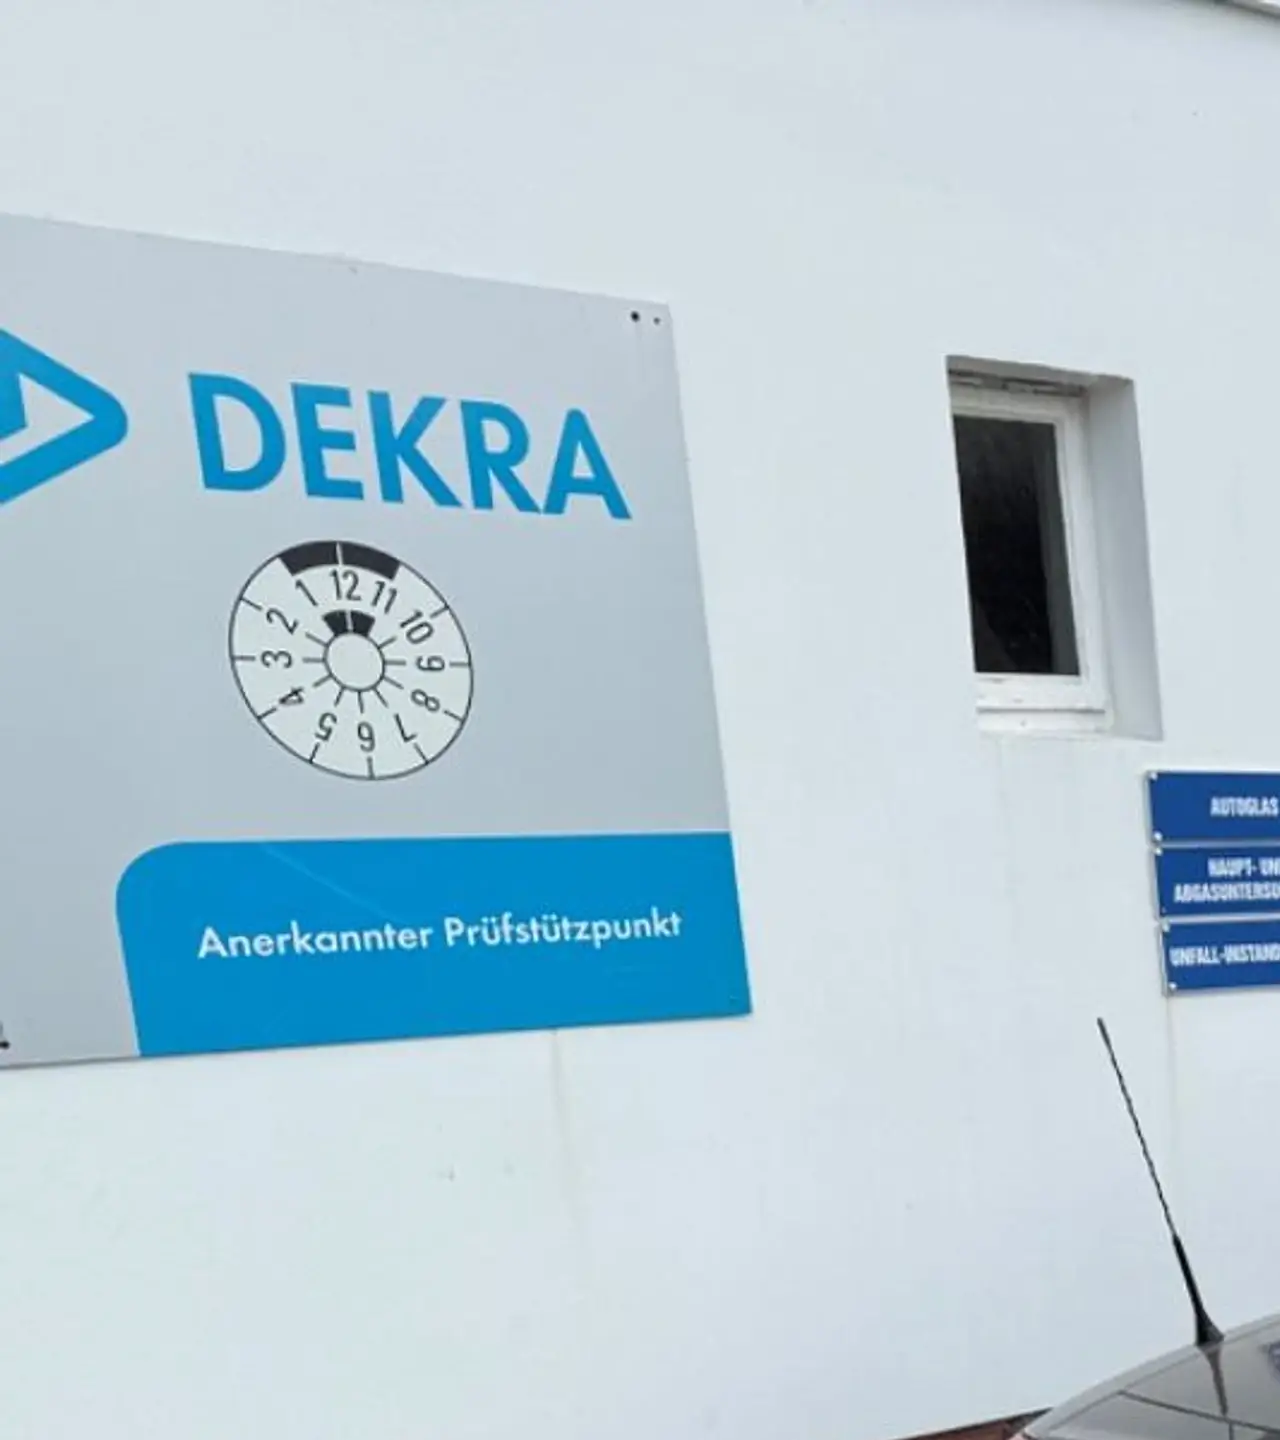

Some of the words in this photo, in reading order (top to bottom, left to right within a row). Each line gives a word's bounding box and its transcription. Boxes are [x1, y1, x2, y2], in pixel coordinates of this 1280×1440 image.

[188, 373, 632, 519] DEKRA
[295, 579, 318, 606] 1
[330, 569, 361, 601] 12
[371, 580, 397, 614] 11
[266, 607, 298, 635] 2
[400, 610, 434, 644] 10
[261, 650, 292, 669] 3
[416, 655, 445, 672] 9
[279, 687, 304, 705] 4
[411, 689, 440, 712] 8
[315, 712, 337, 741] 5
[357, 721, 376, 752] 6
[394, 713, 418, 743] 7
[1210, 796, 1280, 817] AUTOGLAS
[198, 921, 433, 958] Anerkannter
[445, 907, 682, 949] Prüfstützpunkt
